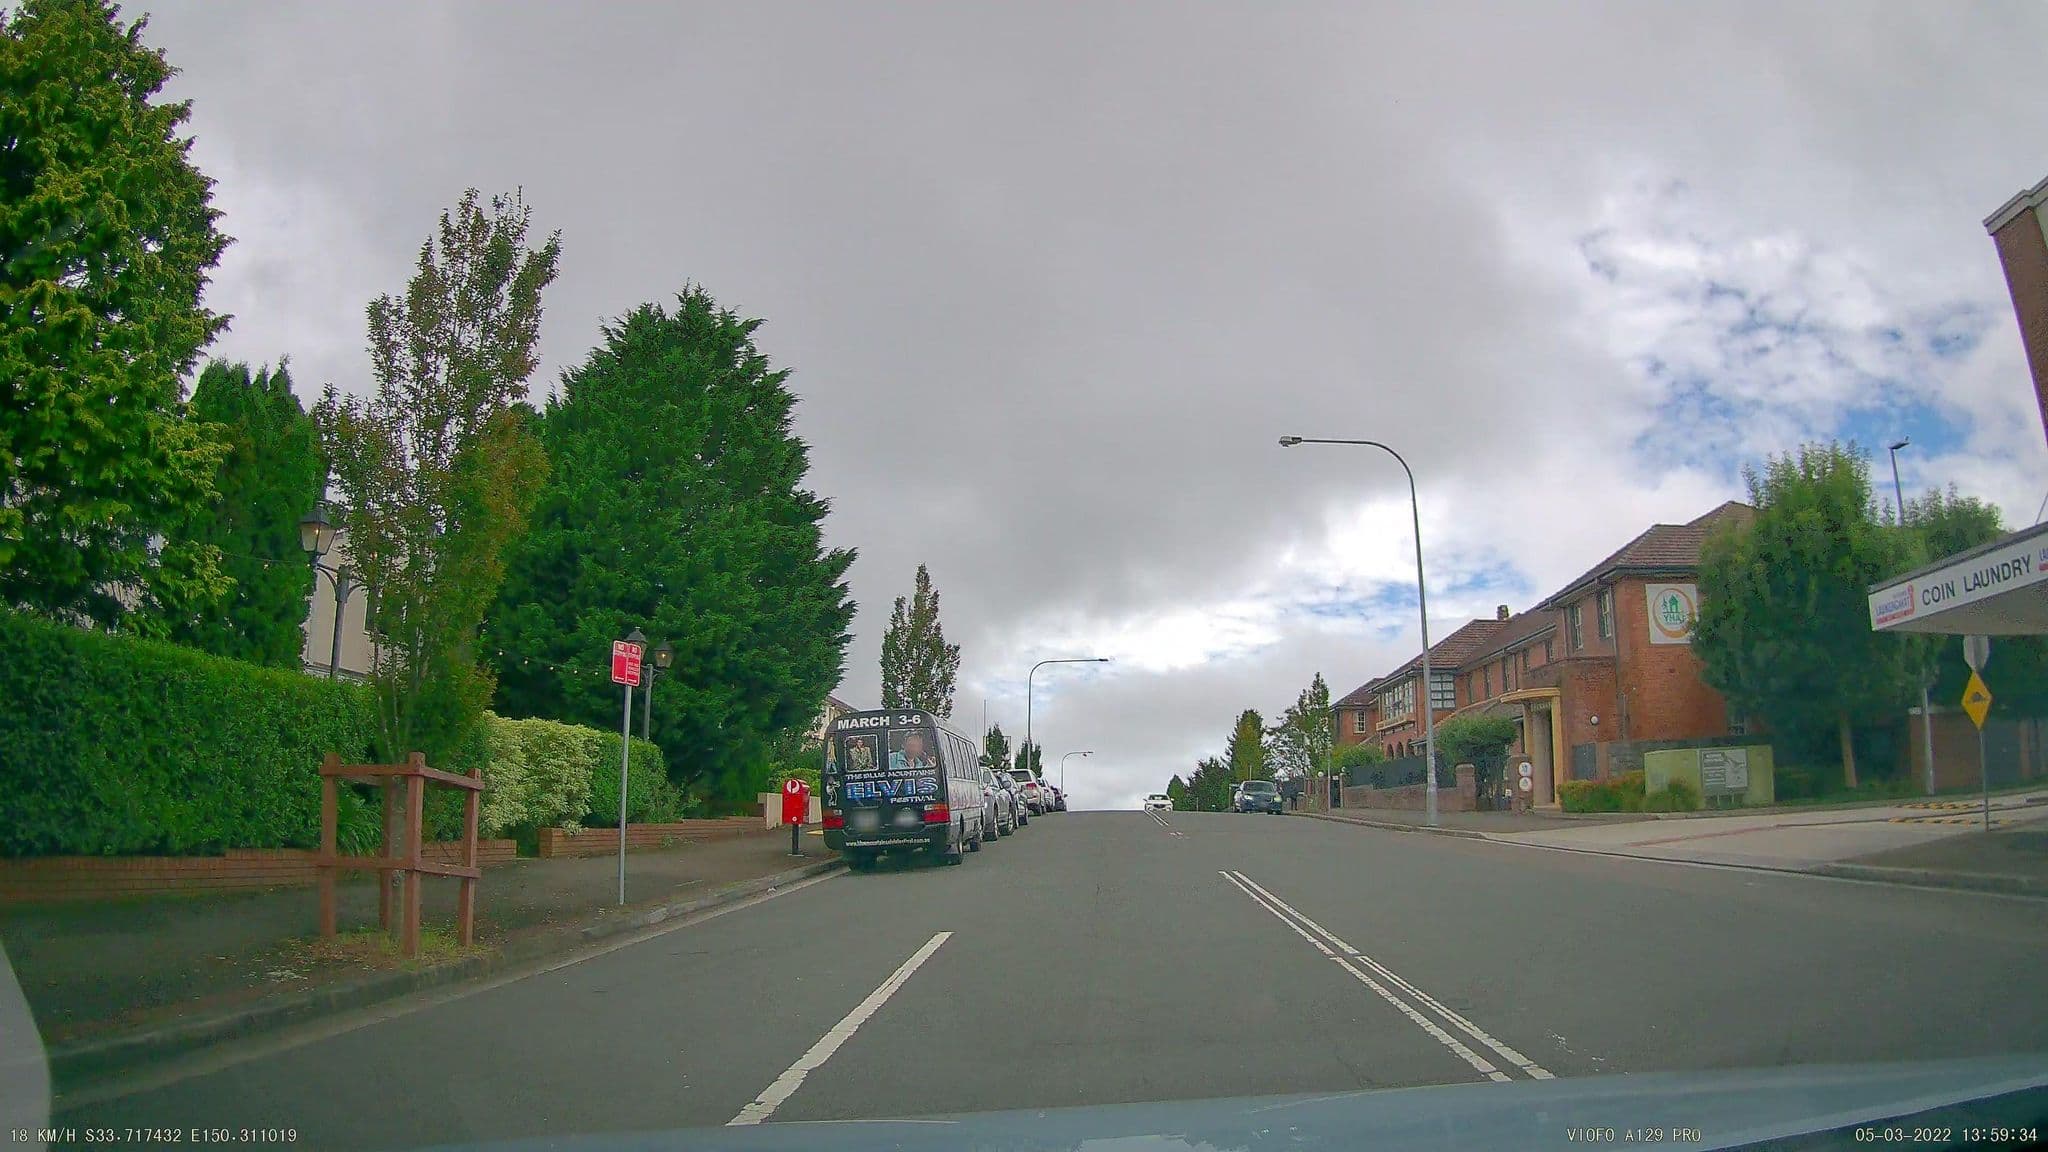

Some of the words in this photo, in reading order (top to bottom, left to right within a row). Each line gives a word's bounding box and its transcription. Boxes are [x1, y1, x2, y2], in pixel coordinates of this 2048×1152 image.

[1922, 581, 1955, 605] COIN
[1963, 554, 2031, 592] LAUNDRY
[837, 716, 890, 730] MARCH
[898, 714, 921, 725] 3-6
[864, 771, 887, 779] BLUE
[888, 769, 936, 778] MOUNTAINS
[846, 777, 939, 799] ELVIS
[890, 795, 936, 804] FESTIVAL
